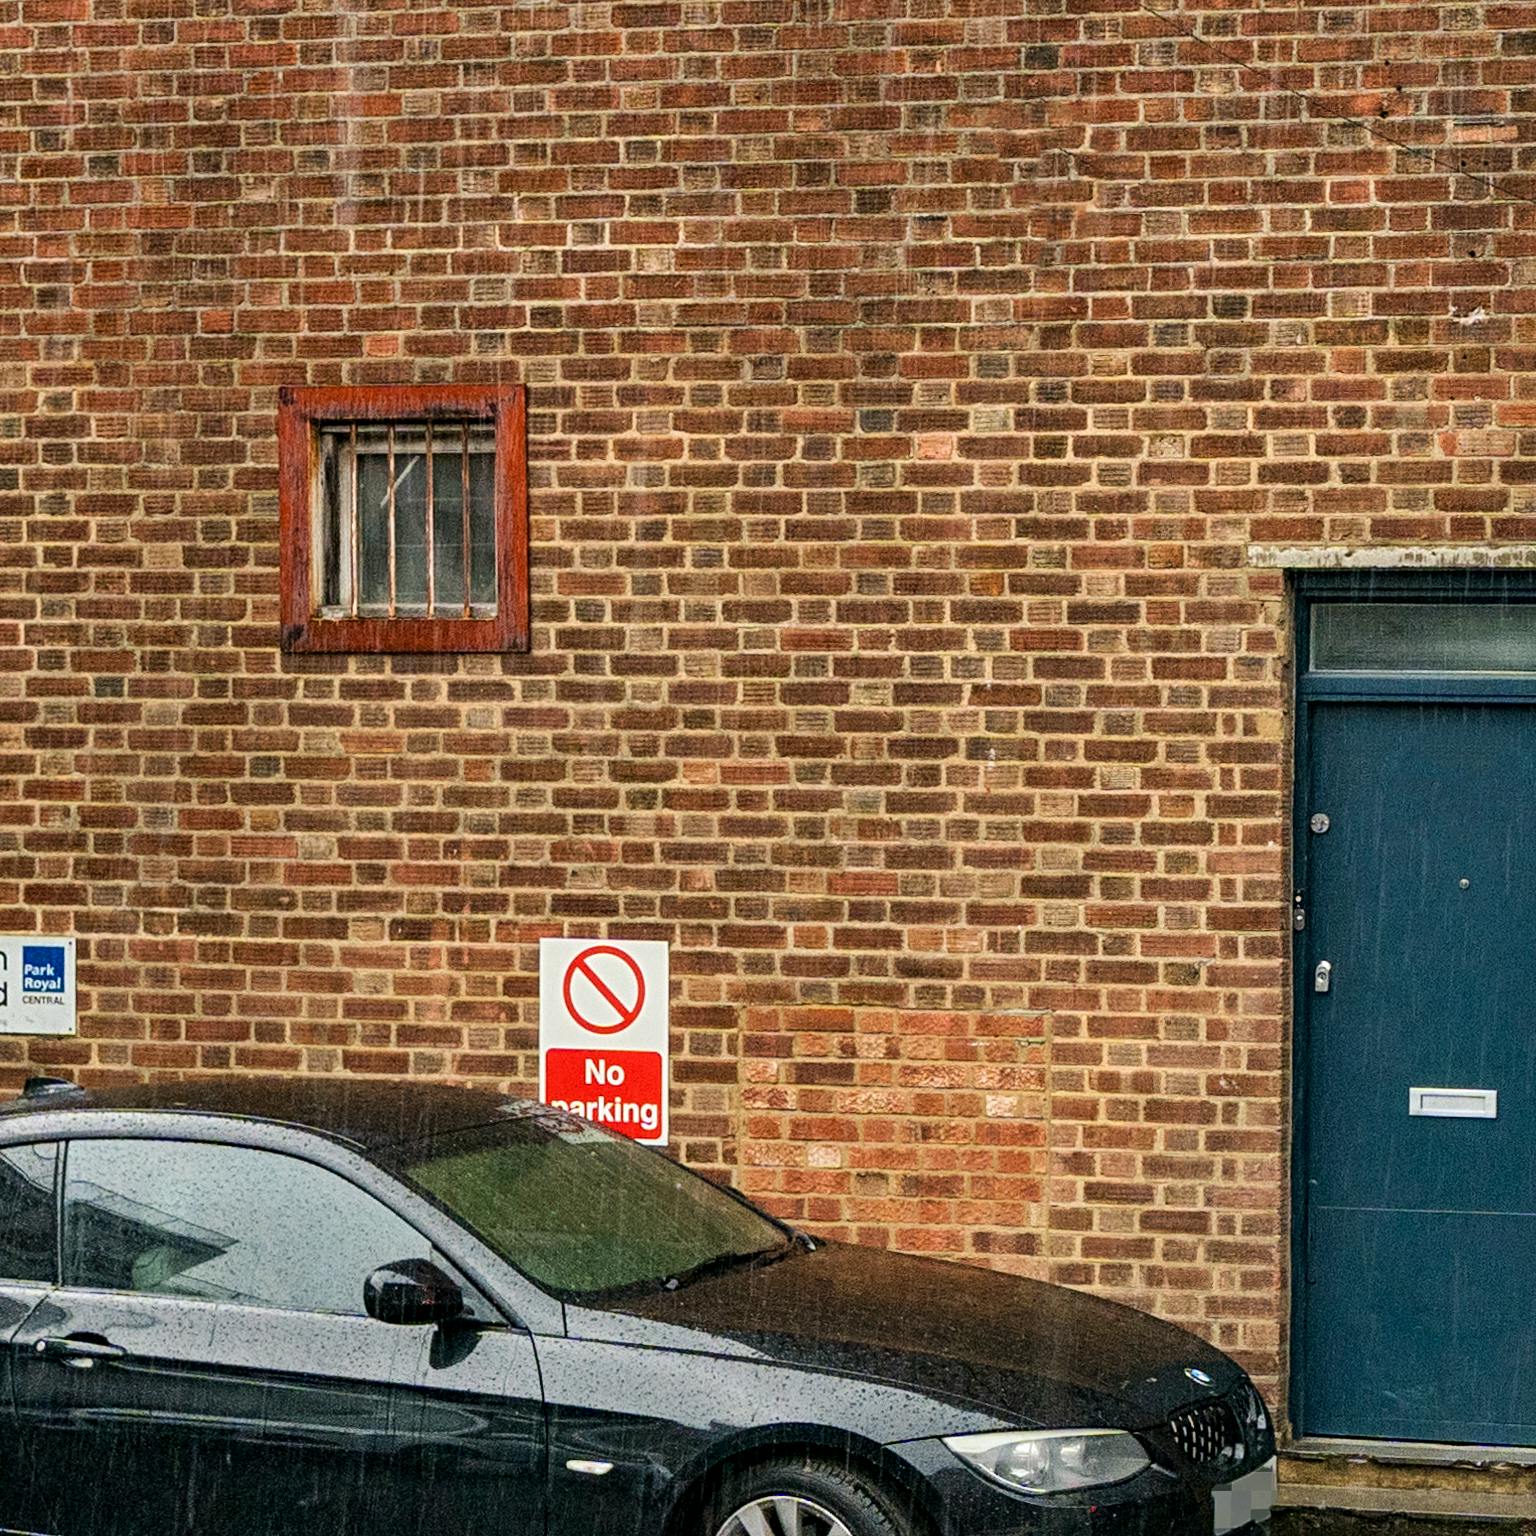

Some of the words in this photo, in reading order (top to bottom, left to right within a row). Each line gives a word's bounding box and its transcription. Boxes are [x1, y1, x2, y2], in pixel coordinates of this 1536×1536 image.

[24, 963, 55, 976] Park
[24, 976, 61, 992] Royal
[22, 995, 65, 1005] CENTRAL
[584, 1058, 625, 1086] No
